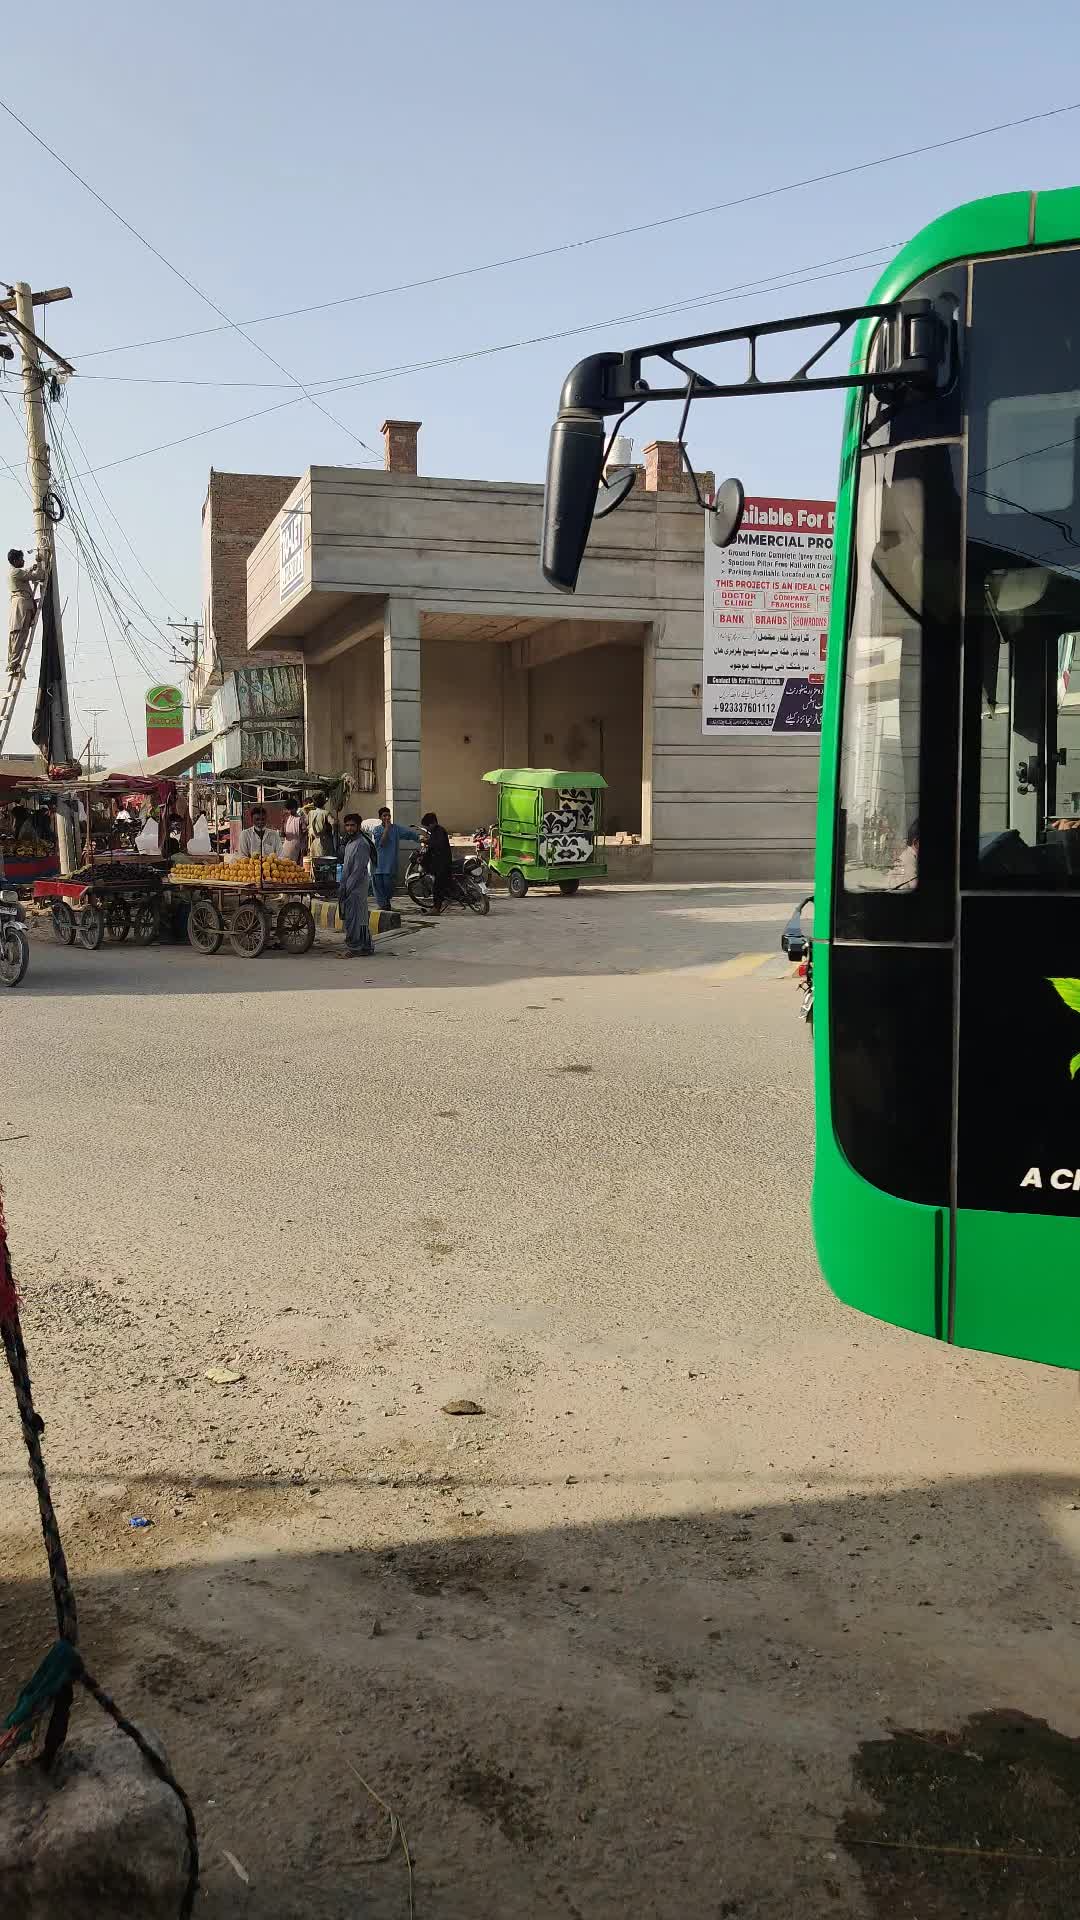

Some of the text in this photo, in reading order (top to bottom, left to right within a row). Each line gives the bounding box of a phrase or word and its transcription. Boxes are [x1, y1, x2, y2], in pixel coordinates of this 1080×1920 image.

[741, 504, 793, 526] ailable
[797, 509, 823, 528] For
[737, 533, 834, 549] MMERCIAL PRO
[716, 579, 831, 591] THIS PROJECT IS AN IDEAL CH
[721, 591, 757, 600] DOCTOR
[773, 594, 809, 602] COMPANY
[820, 595, 831, 603] RE
[724, 599, 753, 607] CLINIC
[770, 601, 812, 609] FRANCHISE
[719, 614, 745, 624] BANK
[755, 615, 788, 625] BRANDS
[712, 676, 731, 684] Contact
[738, 677, 747, 685] For
[747, 677, 765, 685] Further
[712, 702, 776, 713] +923337601112
[1019, 1167, 1043, 1188] A
